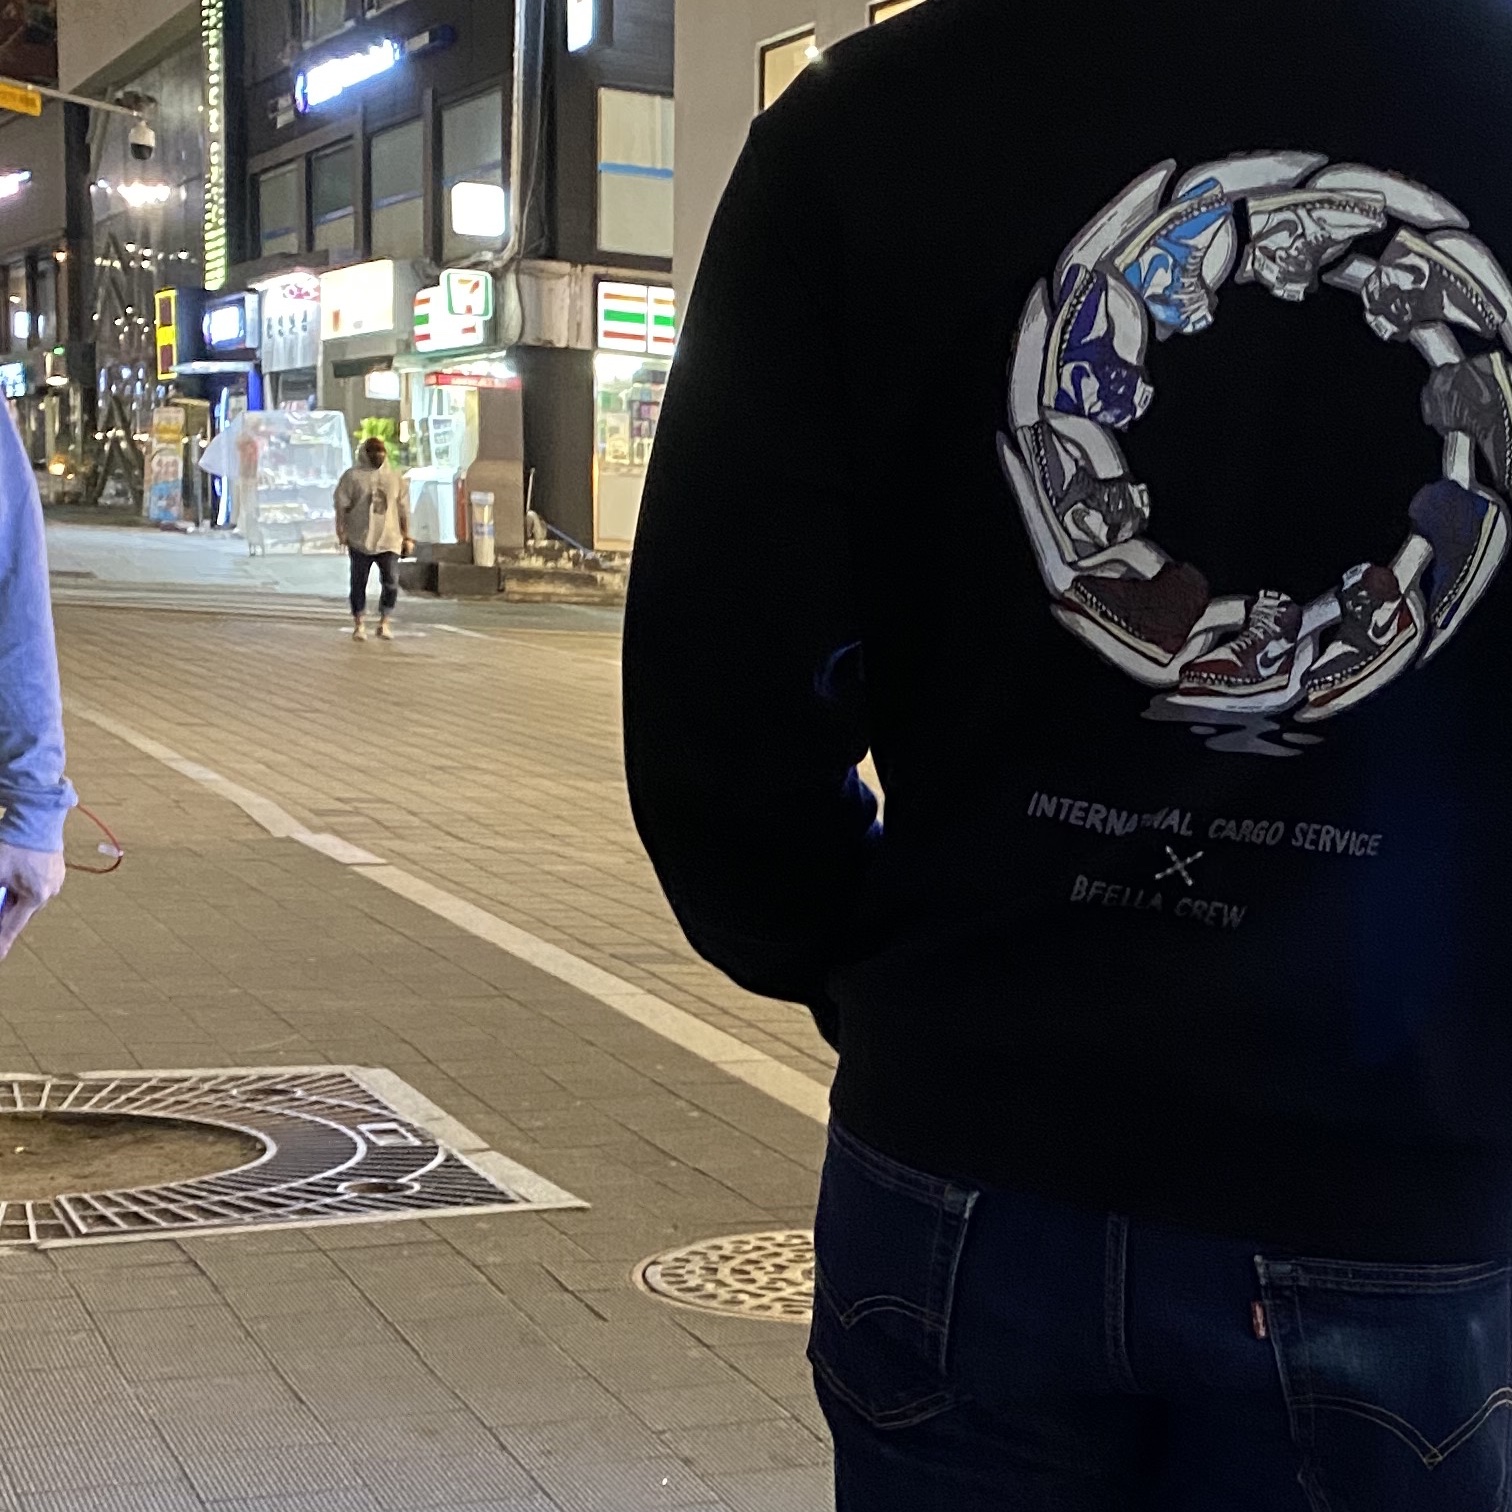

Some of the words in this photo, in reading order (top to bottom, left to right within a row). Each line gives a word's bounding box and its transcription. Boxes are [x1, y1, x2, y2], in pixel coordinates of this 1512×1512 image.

[1208, 818, 1285, 846] CARGO
[1291, 821, 1383, 857] SERVICE
[1174, 897, 1247, 929] CREW
